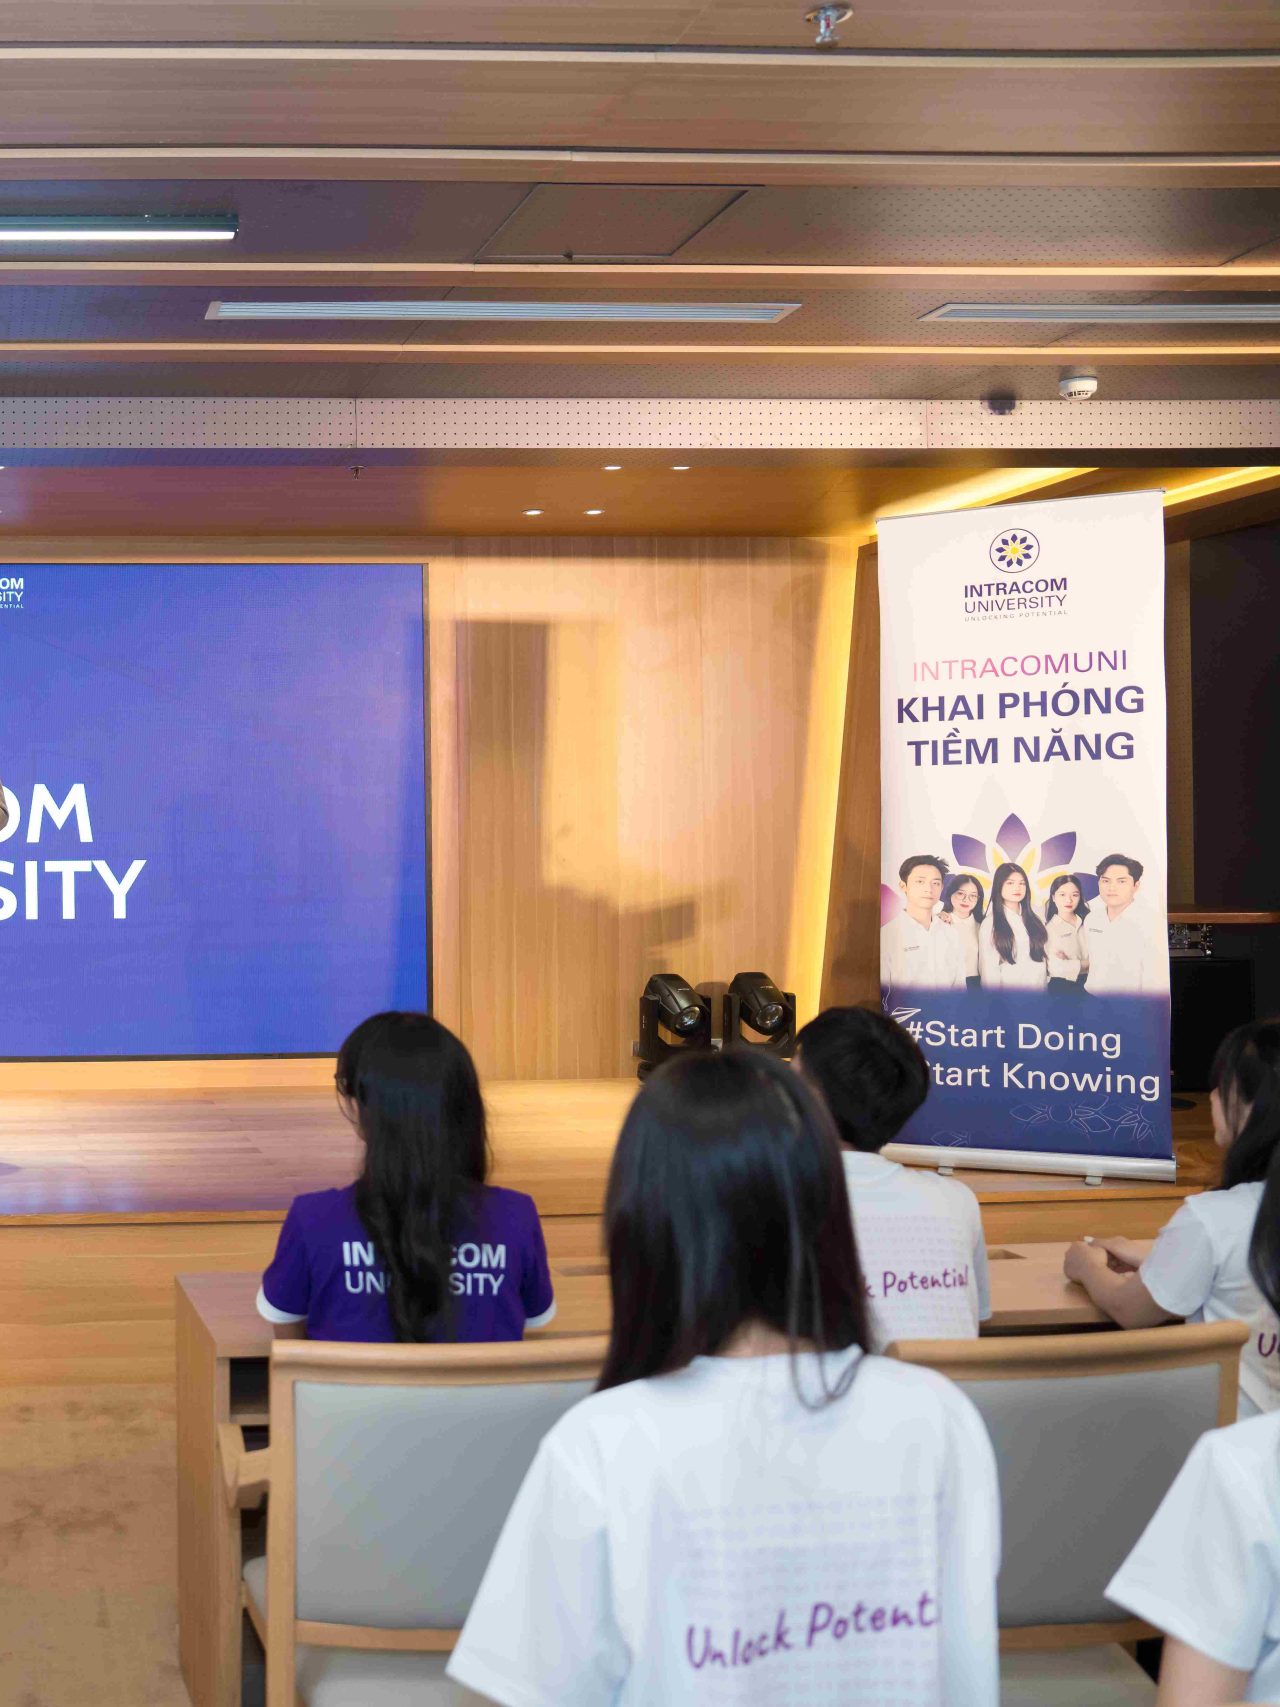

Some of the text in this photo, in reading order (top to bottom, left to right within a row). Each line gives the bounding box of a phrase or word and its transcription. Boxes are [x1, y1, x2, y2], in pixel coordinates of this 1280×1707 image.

[964, 577, 1068, 598] INTRACOM
[964, 594, 1067, 613] UNIVERSITY
[964, 610, 1068, 622] UNLOCKING POTENTIAL
[913, 650, 1127, 682] INTRACOMUNI
[897, 682, 1144, 723] KHAI PHÓNG
[907, 727, 1134, 766] TIỀM NĂNG
[905, 1020, 1121, 1059] #Start Doing
[925, 1060, 1160, 1101] tart Knowing
[342, 1241, 506, 1269] INOM
[344, 1271, 505, 1296] UNSITY
[686, 1590, 938, 1670] Unlock Potent
